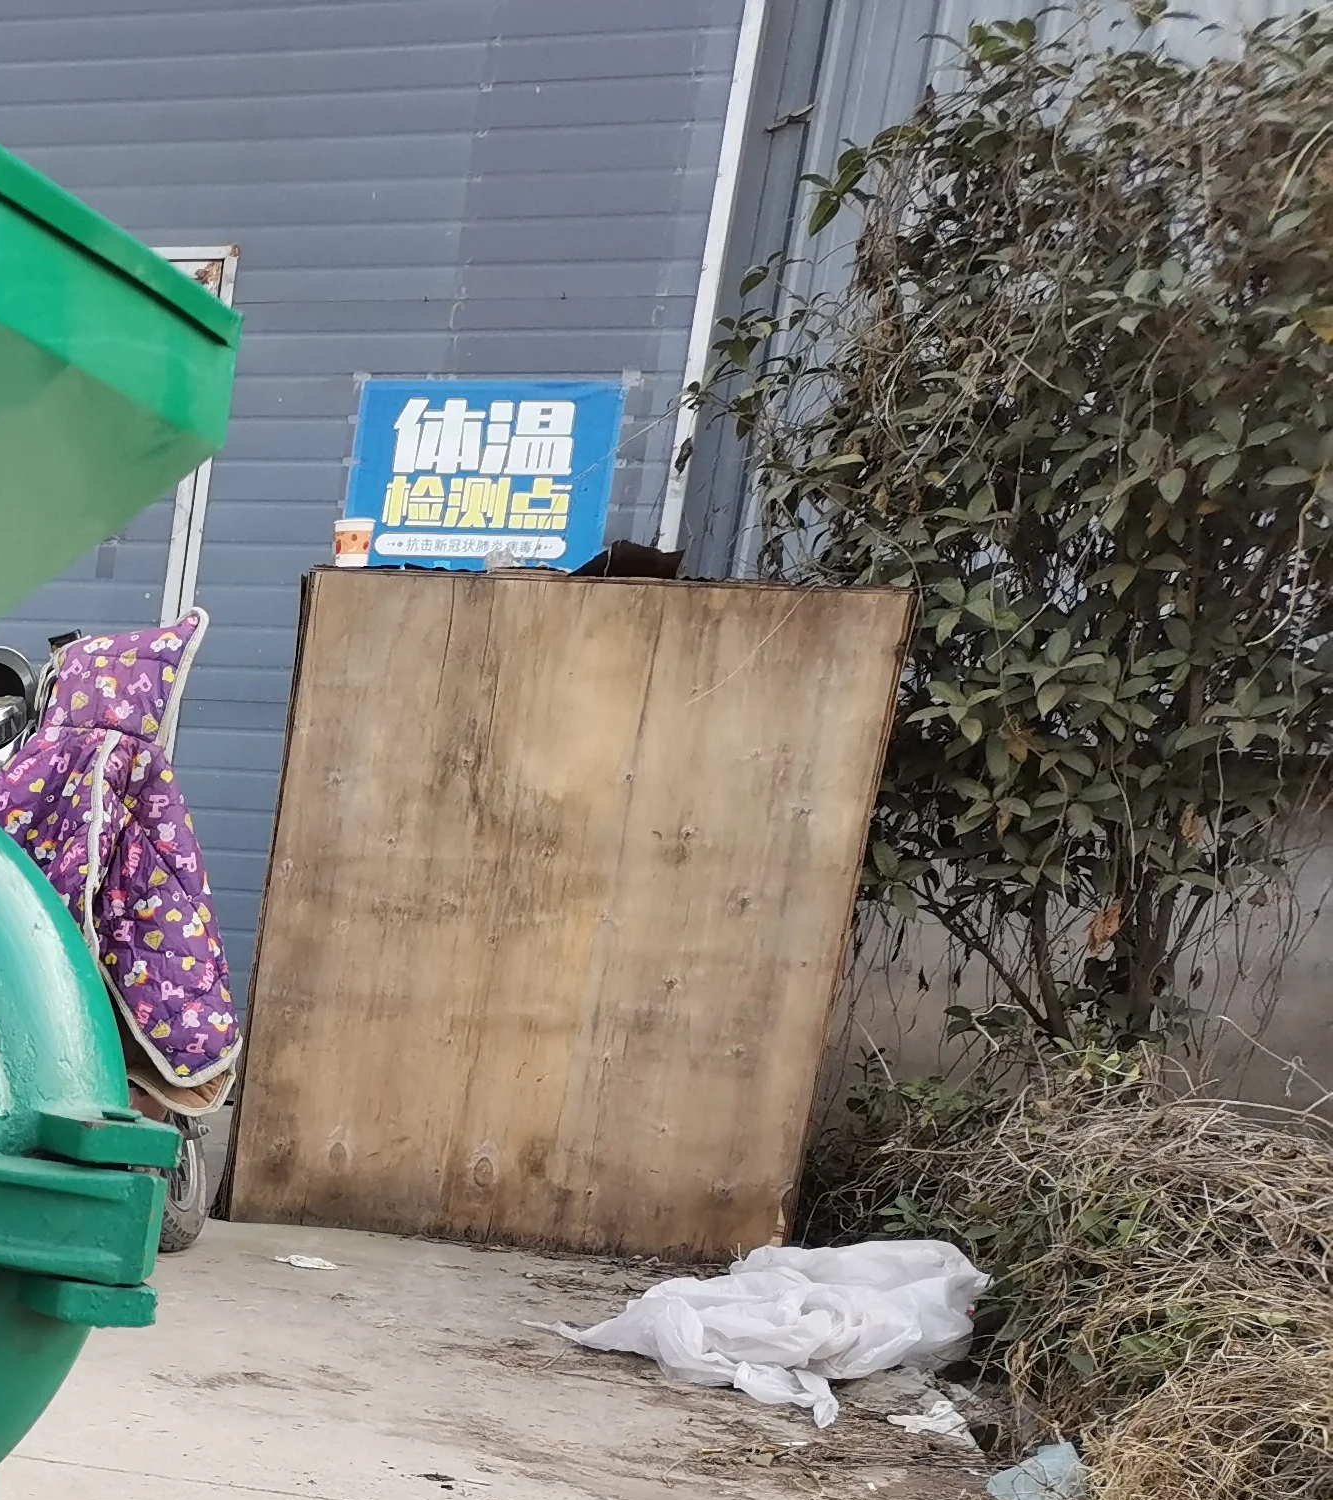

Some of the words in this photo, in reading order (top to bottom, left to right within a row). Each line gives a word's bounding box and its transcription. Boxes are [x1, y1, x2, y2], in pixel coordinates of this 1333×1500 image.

[393, 397, 576, 475] 体温
[382, 475, 573, 530] 检测点
